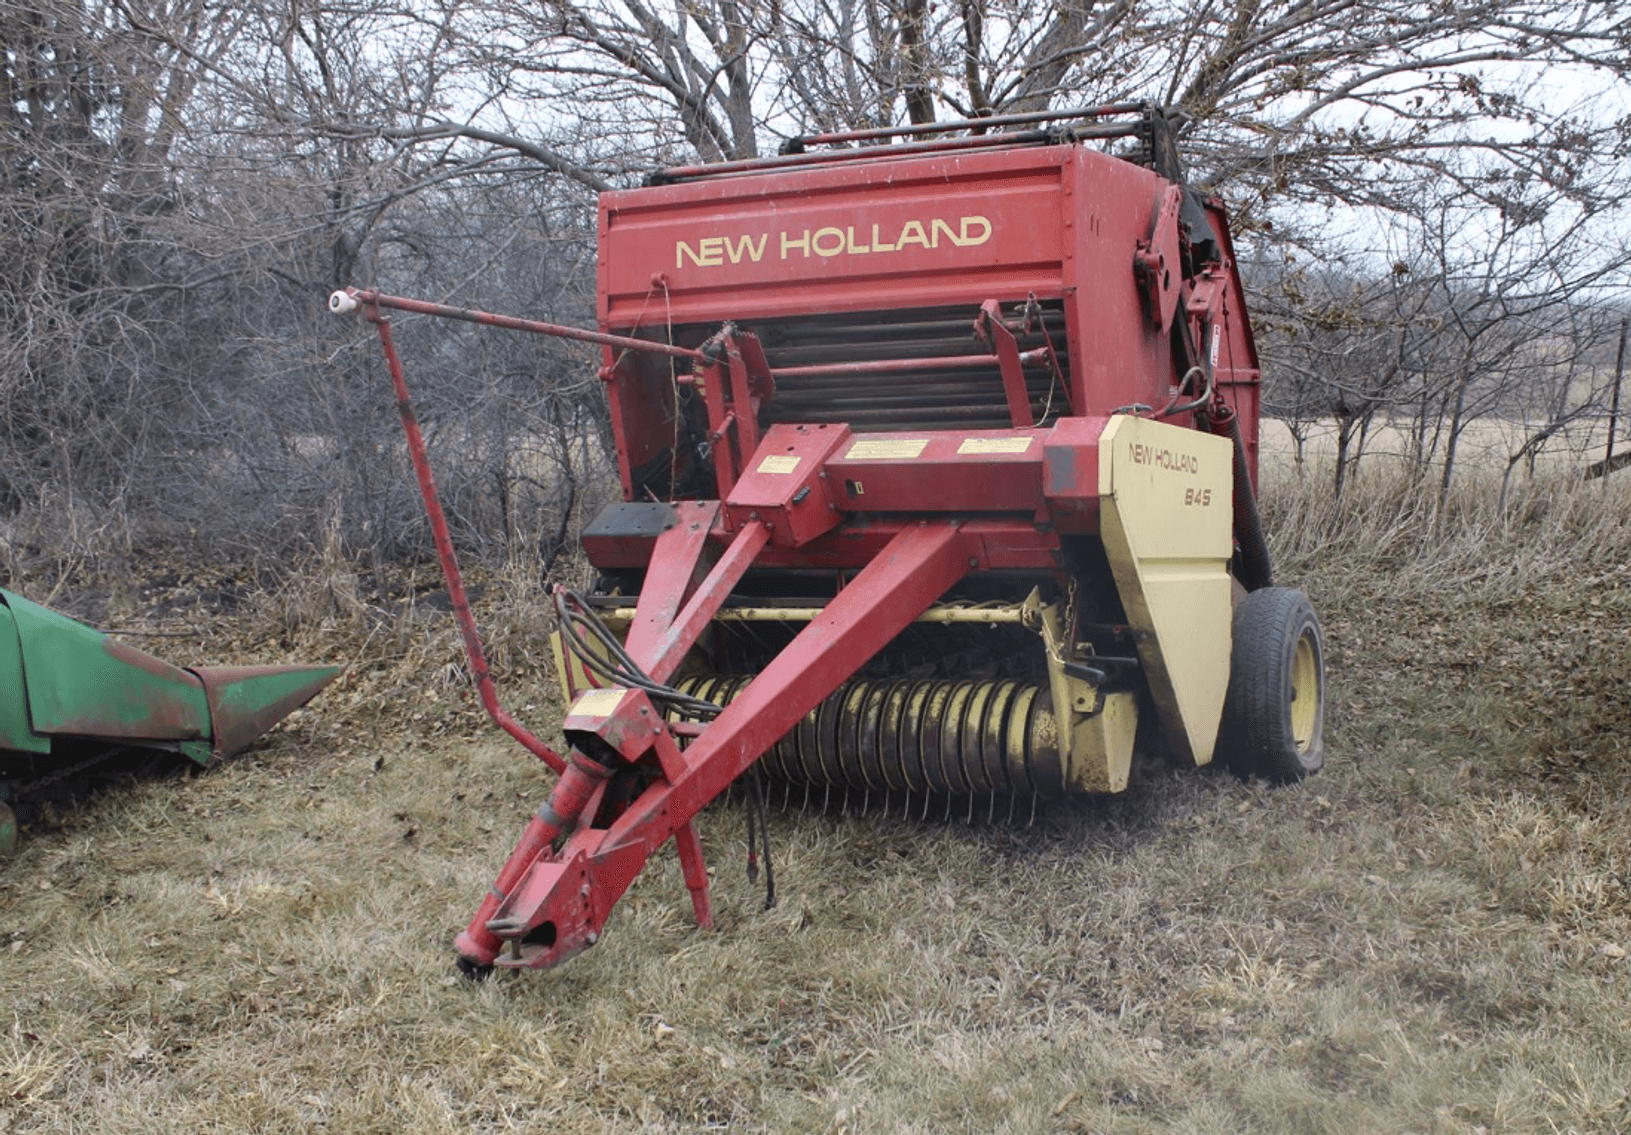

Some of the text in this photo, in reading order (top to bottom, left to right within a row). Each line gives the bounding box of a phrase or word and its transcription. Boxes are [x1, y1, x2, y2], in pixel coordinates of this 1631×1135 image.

[676, 215, 993, 268] NEW HOLLAND
[1129, 443, 1198, 474] NEW HOLLAND
[1184, 488, 1211, 506] 845
